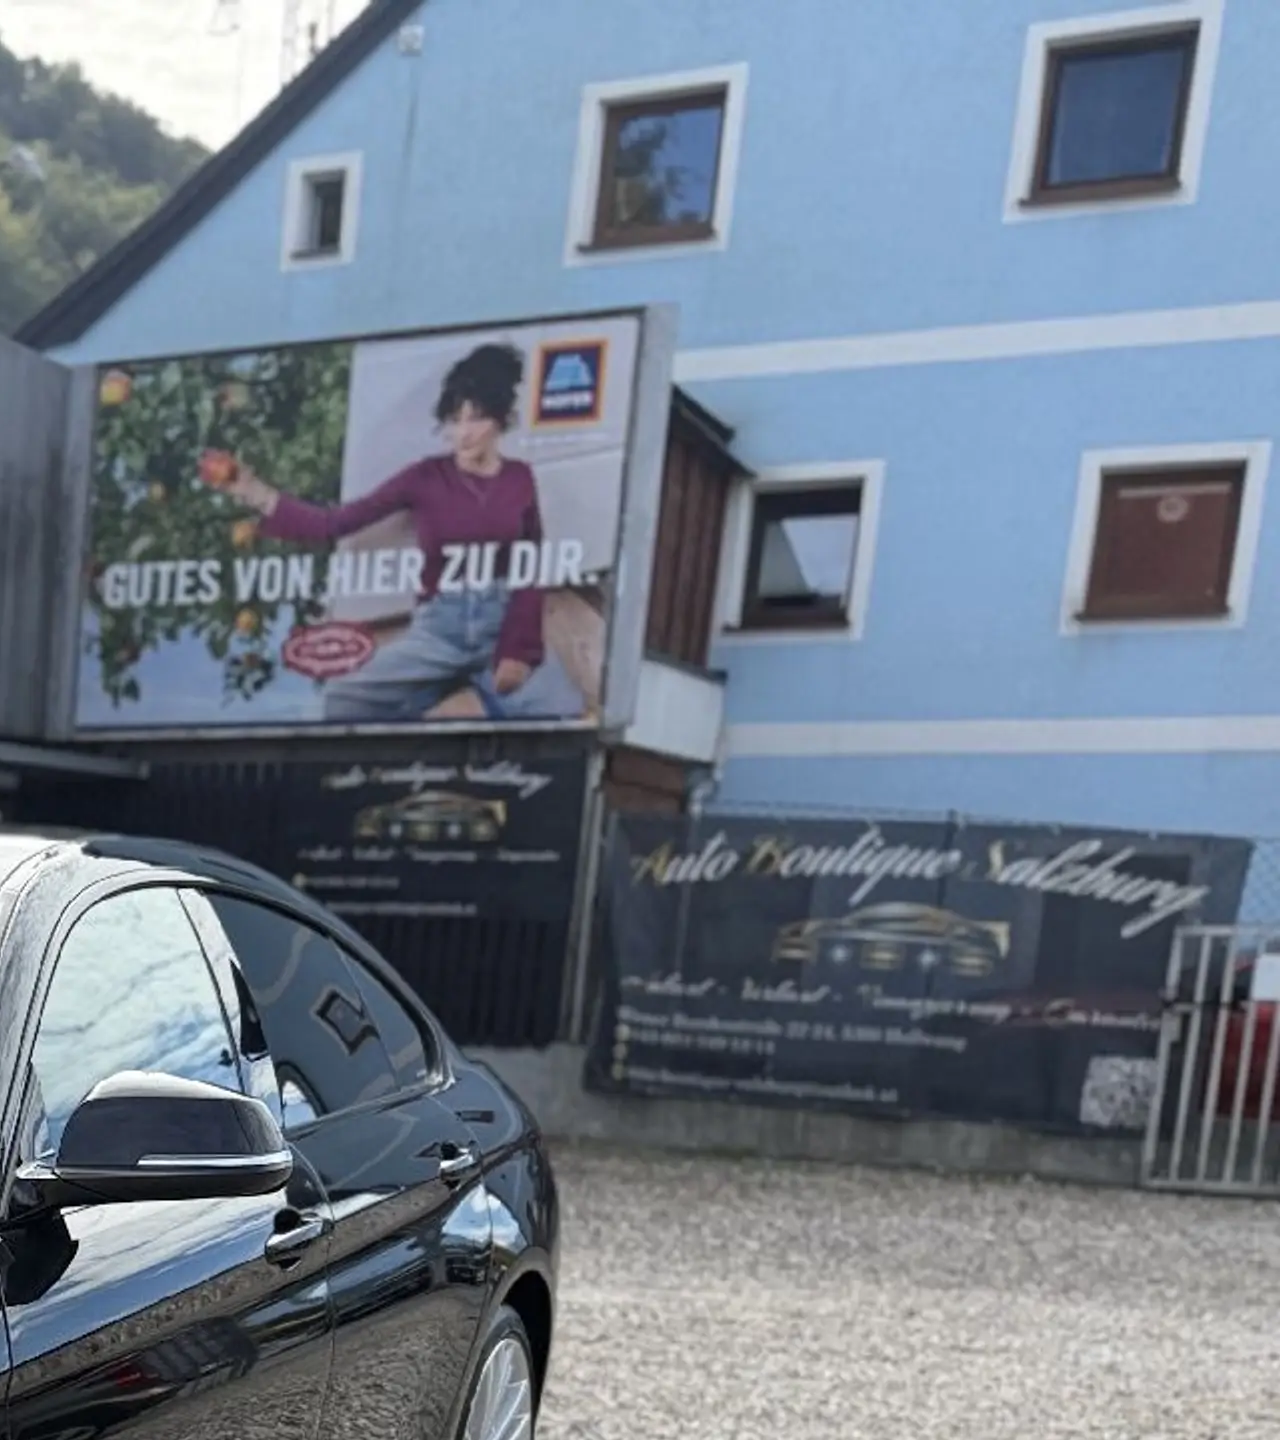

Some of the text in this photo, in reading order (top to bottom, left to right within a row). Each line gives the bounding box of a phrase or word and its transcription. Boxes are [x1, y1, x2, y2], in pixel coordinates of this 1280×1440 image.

[104, 537, 600, 608] GUTES VON HIER ZU DIR.
[631, 820, 1210, 939] Auto Boutique Salzburg
